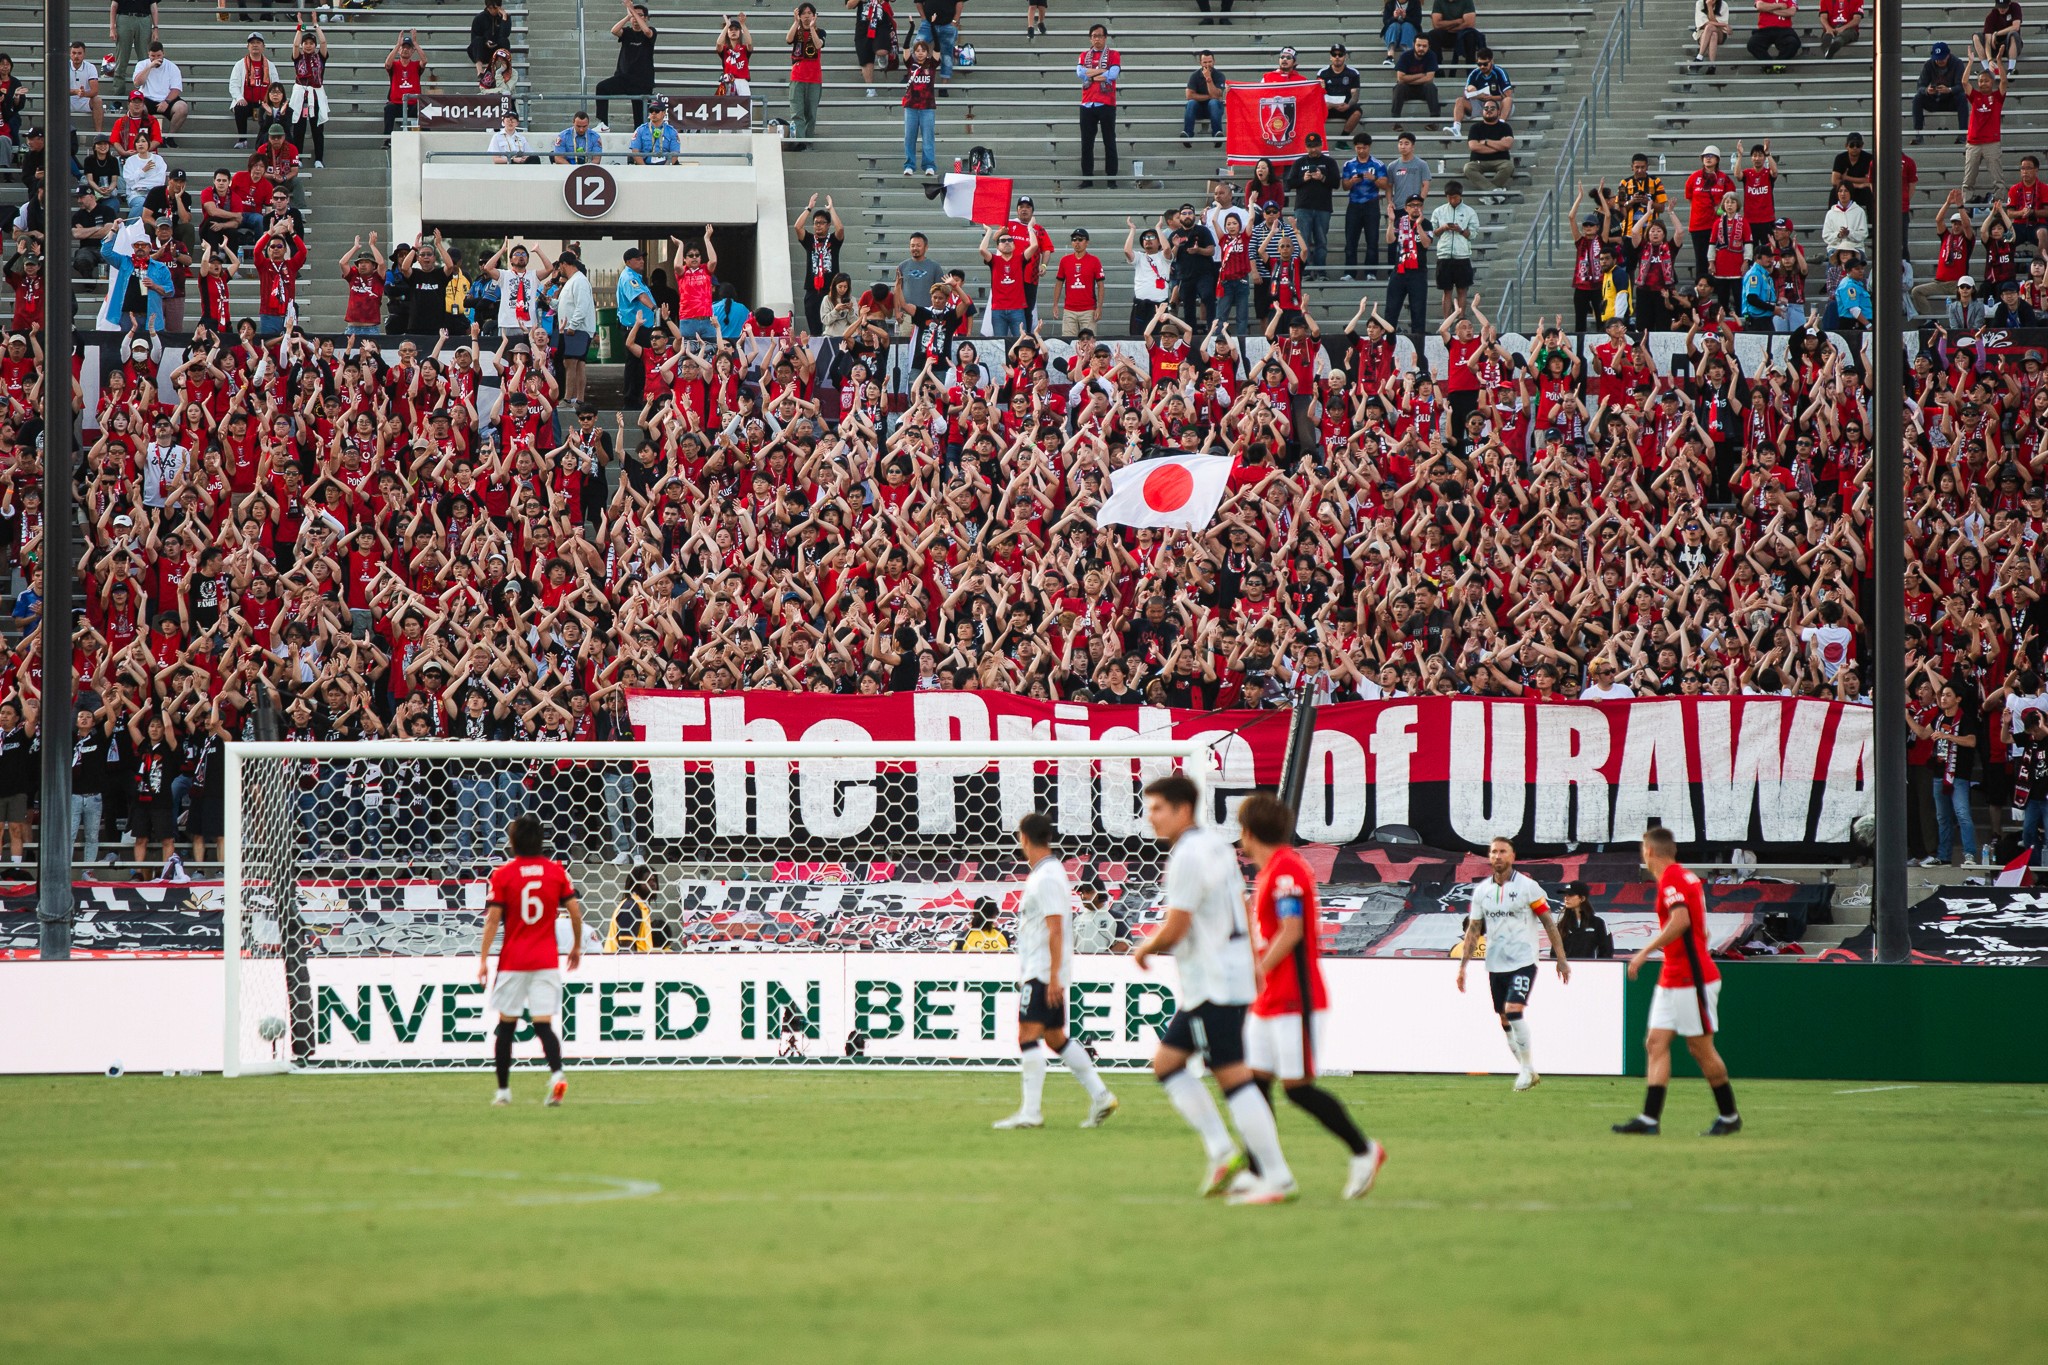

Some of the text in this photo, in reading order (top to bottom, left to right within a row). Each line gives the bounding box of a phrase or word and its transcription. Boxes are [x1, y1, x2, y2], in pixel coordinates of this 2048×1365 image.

[442, 105, 500, 118] 101-141
[673, 103, 722, 121] 1-41
[1695, 177, 1701, 186] 5
[576, 176, 605, 206] 12
[1747, 185, 1769, 196] POLUS
[1325, 436, 1347, 446] POLUS
[627, 692, 1875, 845] The Pride of URAWA
[521, 881, 544, 925] 6
[1513, 976, 1530, 992] 93
[317, 981, 712, 1043] NVETED
[741, 980, 820, 1040] IN
[855, 980, 1178, 1043] BETER
